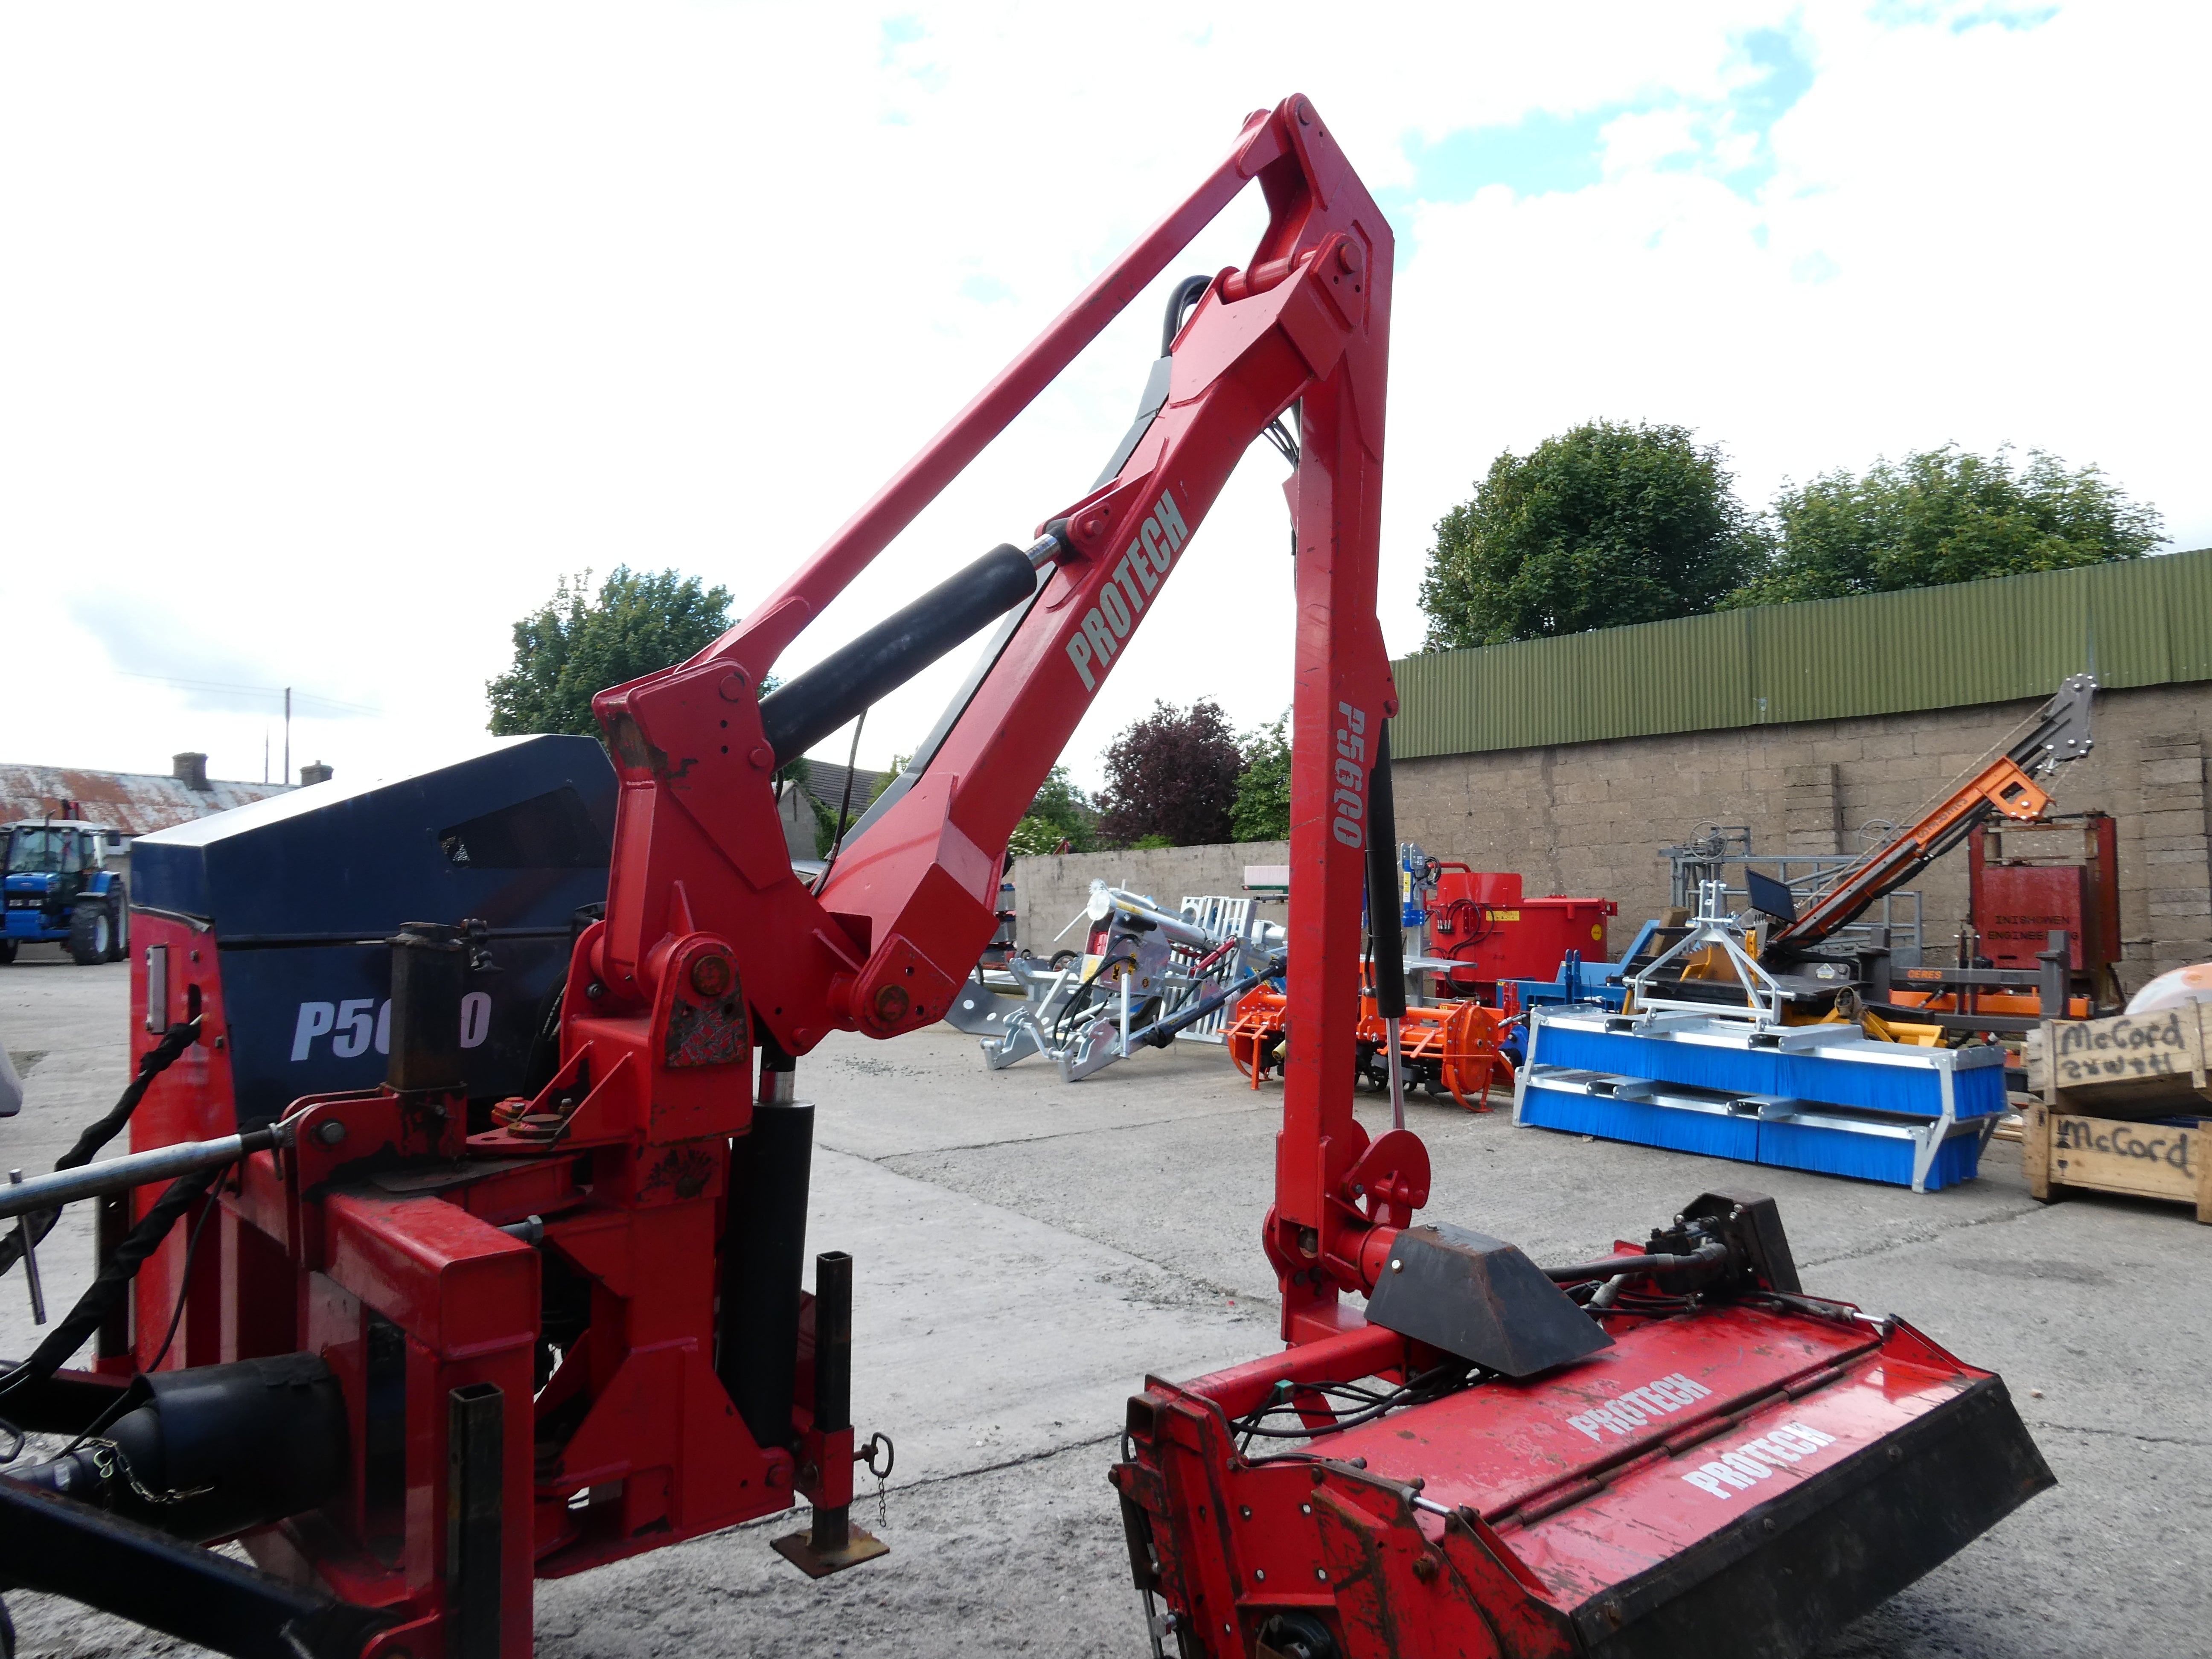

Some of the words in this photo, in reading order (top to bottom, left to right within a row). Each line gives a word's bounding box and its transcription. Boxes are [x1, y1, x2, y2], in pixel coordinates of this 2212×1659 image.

[1065, 489, 1188, 692] PROTECH
[1333, 701, 1365, 848] P5600
[1988, 931, 2078, 940] ENGINEEG
[1995, 915, 2069, 925] INISHOWEN
[1907, 969, 1942, 979] CERES
[291, 991, 492, 1061] P50
[2061, 1013, 2186, 1054] McCord
[2064, 1121, 2195, 1179] McCord
[1566, 1373, 1712, 1443] PROTECH
[1681, 1421, 1837, 1499] PROTECH
